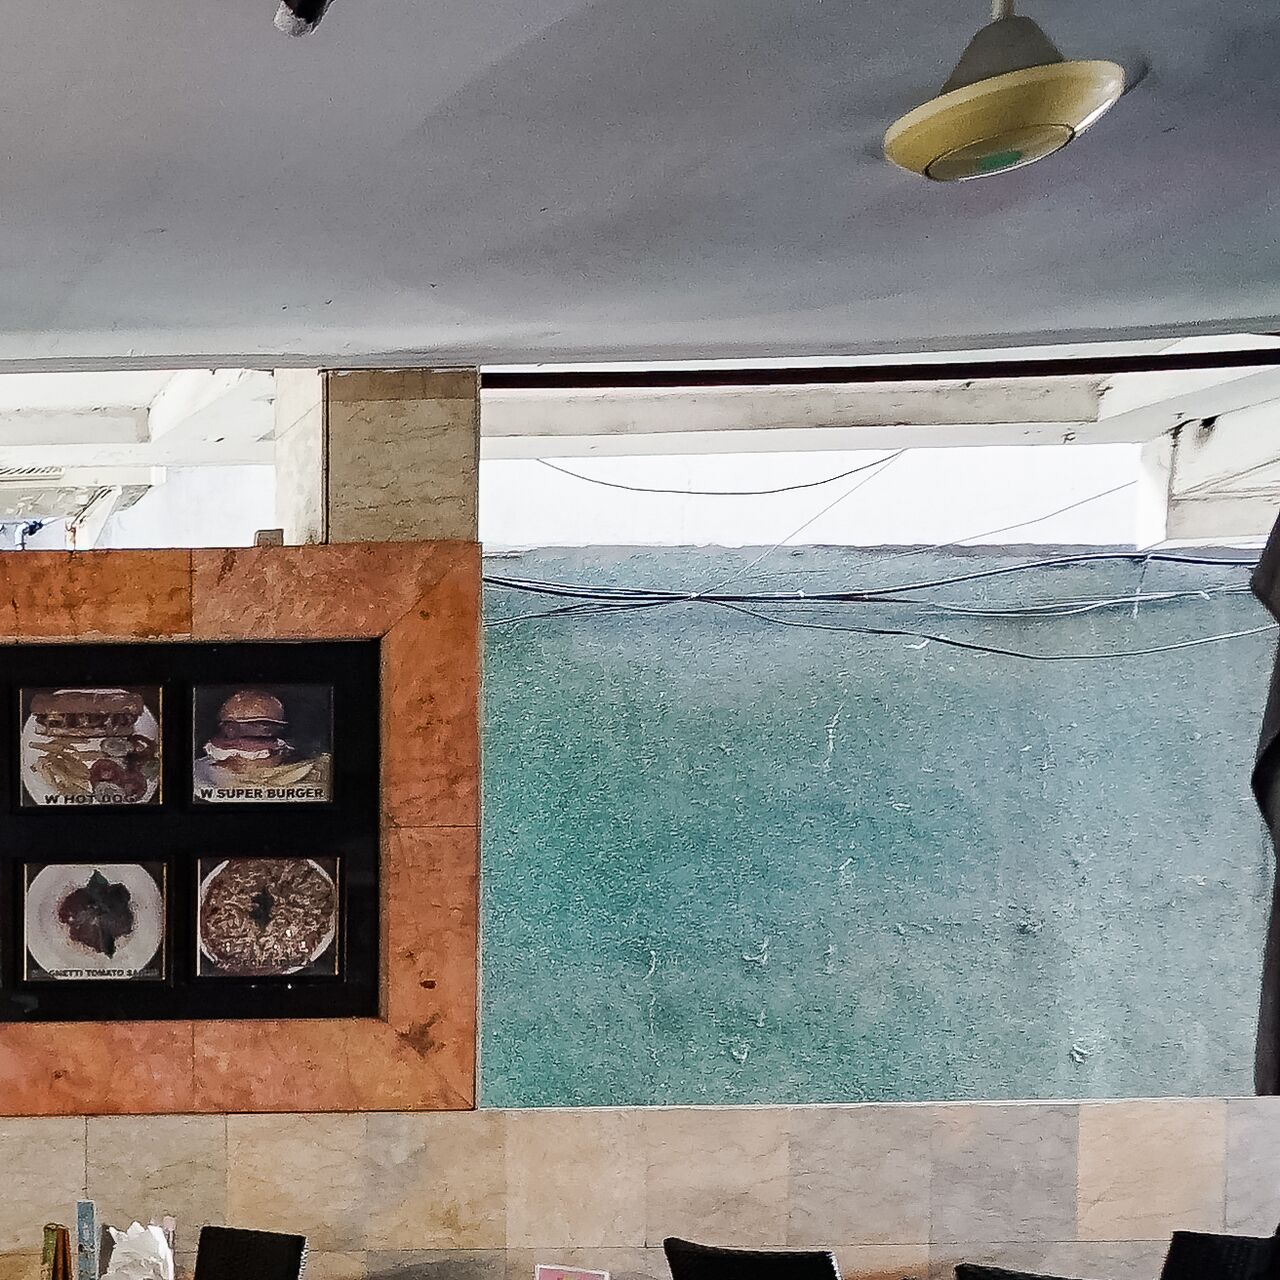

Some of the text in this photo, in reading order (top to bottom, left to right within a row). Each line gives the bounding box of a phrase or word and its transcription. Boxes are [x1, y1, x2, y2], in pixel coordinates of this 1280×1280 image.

[200, 787, 325, 798] W SUPER BURGER
[44, 794, 59, 804] W
[64, 794, 95, 804] HOT
[32, 969, 81, 977] GHETTI
[84, 969, 124, 977] TOMATO
